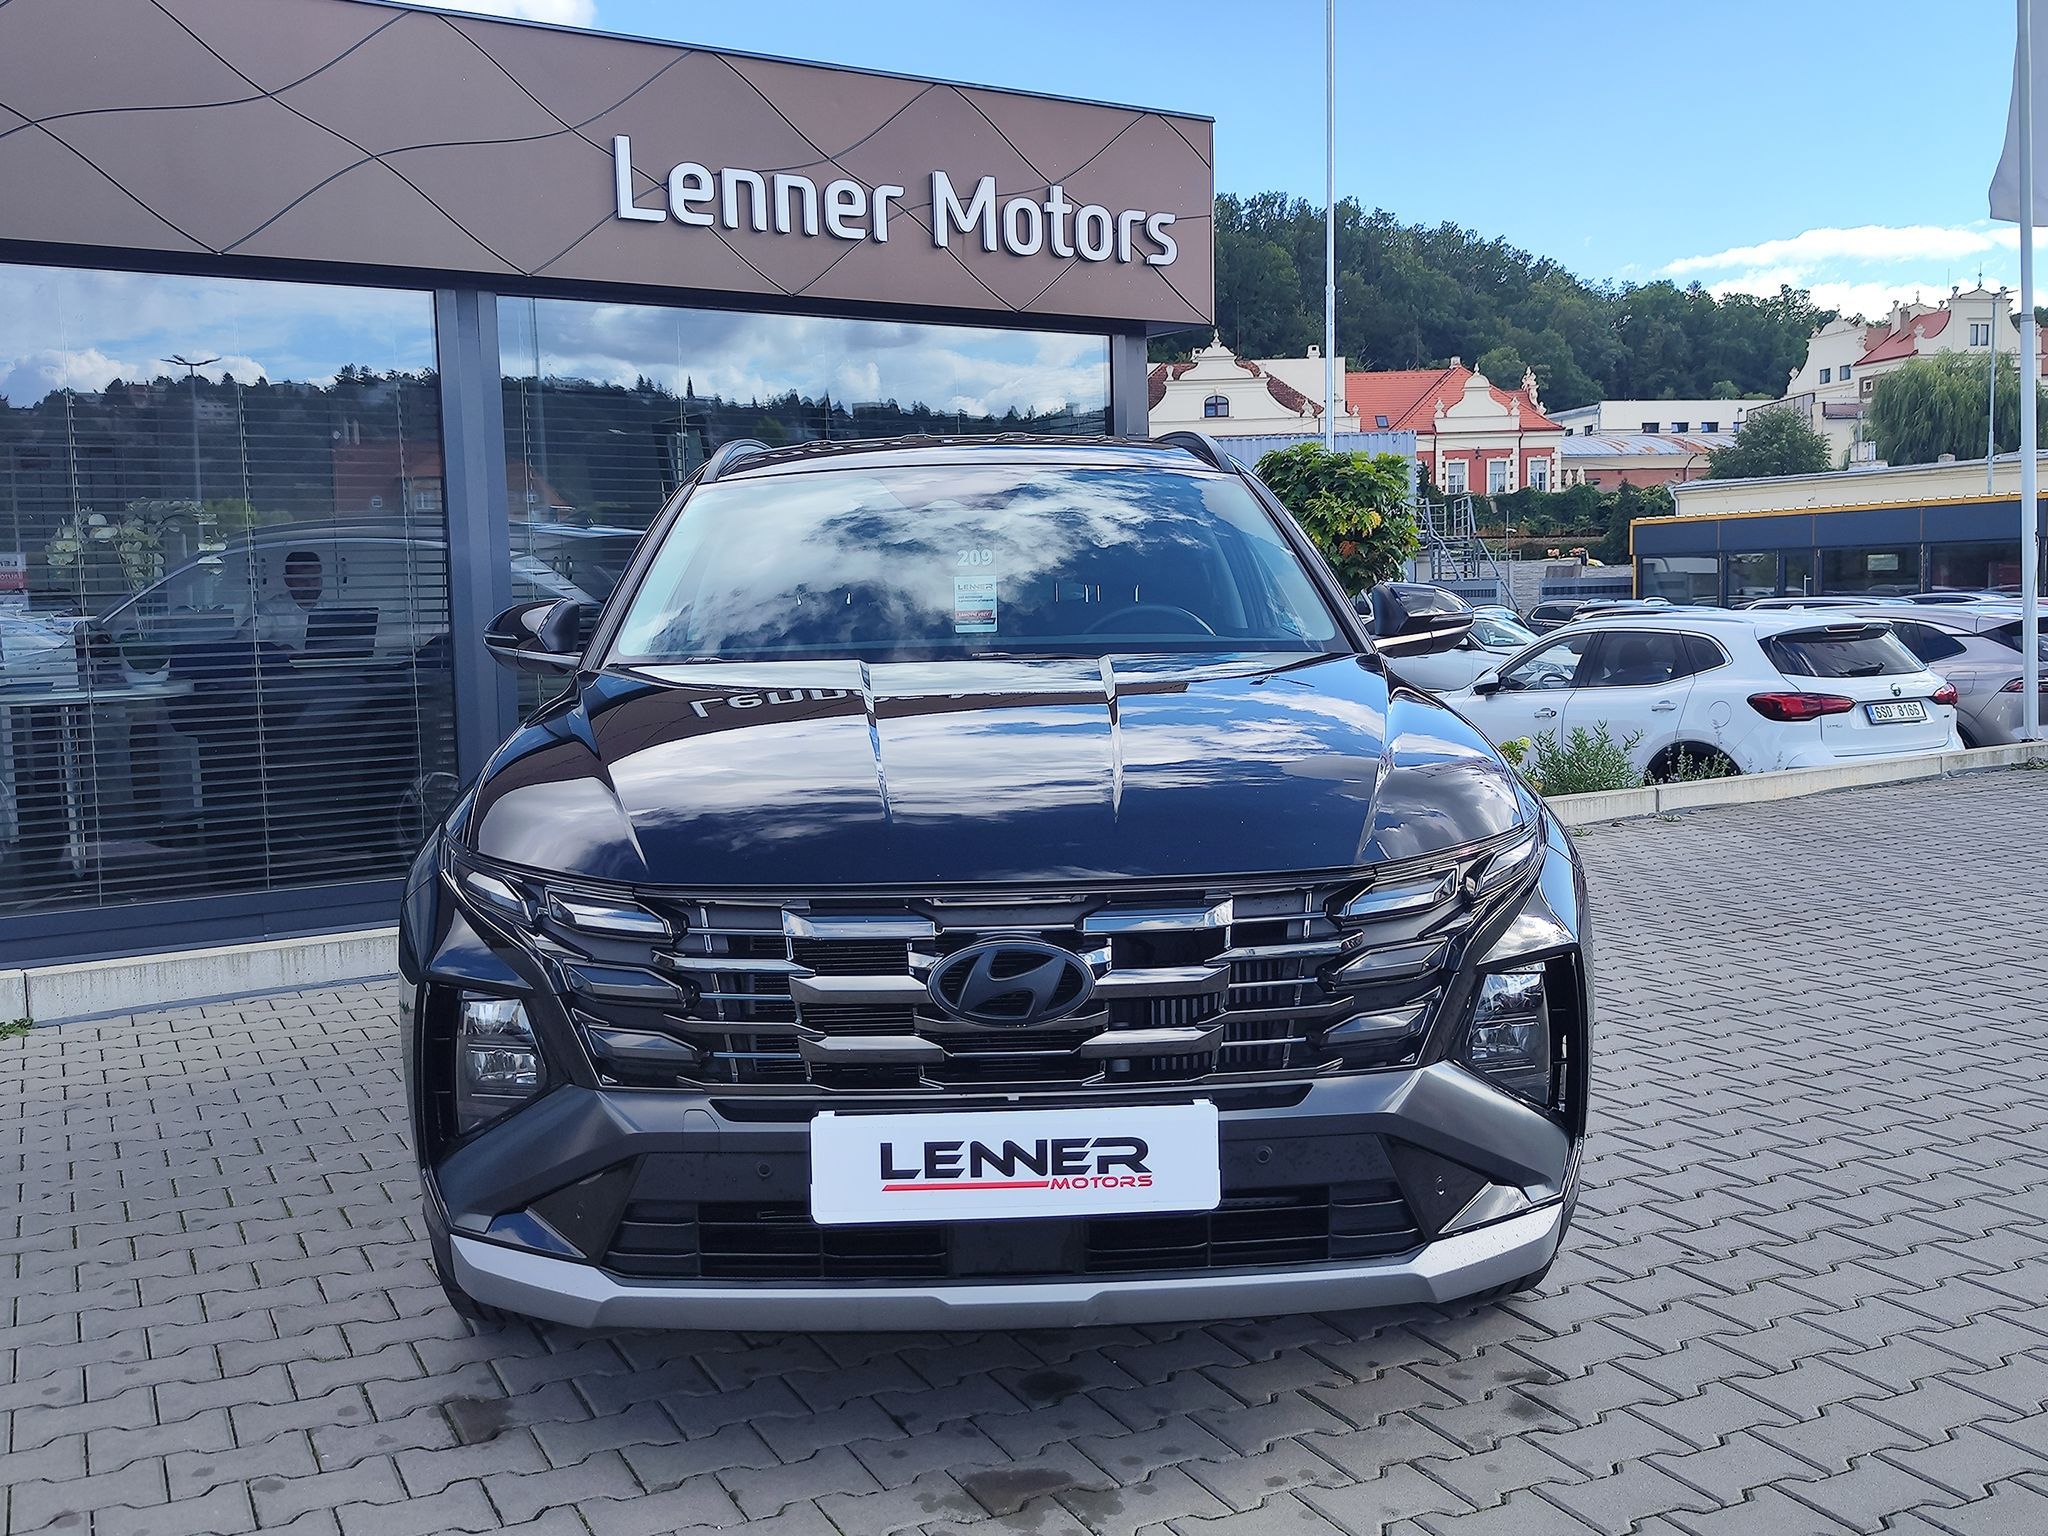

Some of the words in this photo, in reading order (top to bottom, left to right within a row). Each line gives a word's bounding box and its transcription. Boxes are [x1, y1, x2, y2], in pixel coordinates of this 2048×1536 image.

[613, 134, 905, 243] Lenner
[930, 169, 1179, 266] Motors
[957, 549, 993, 566] 209
[880, 1137, 1152, 1180] LENNER
[1050, 1174, 1153, 1190] MOTORS
